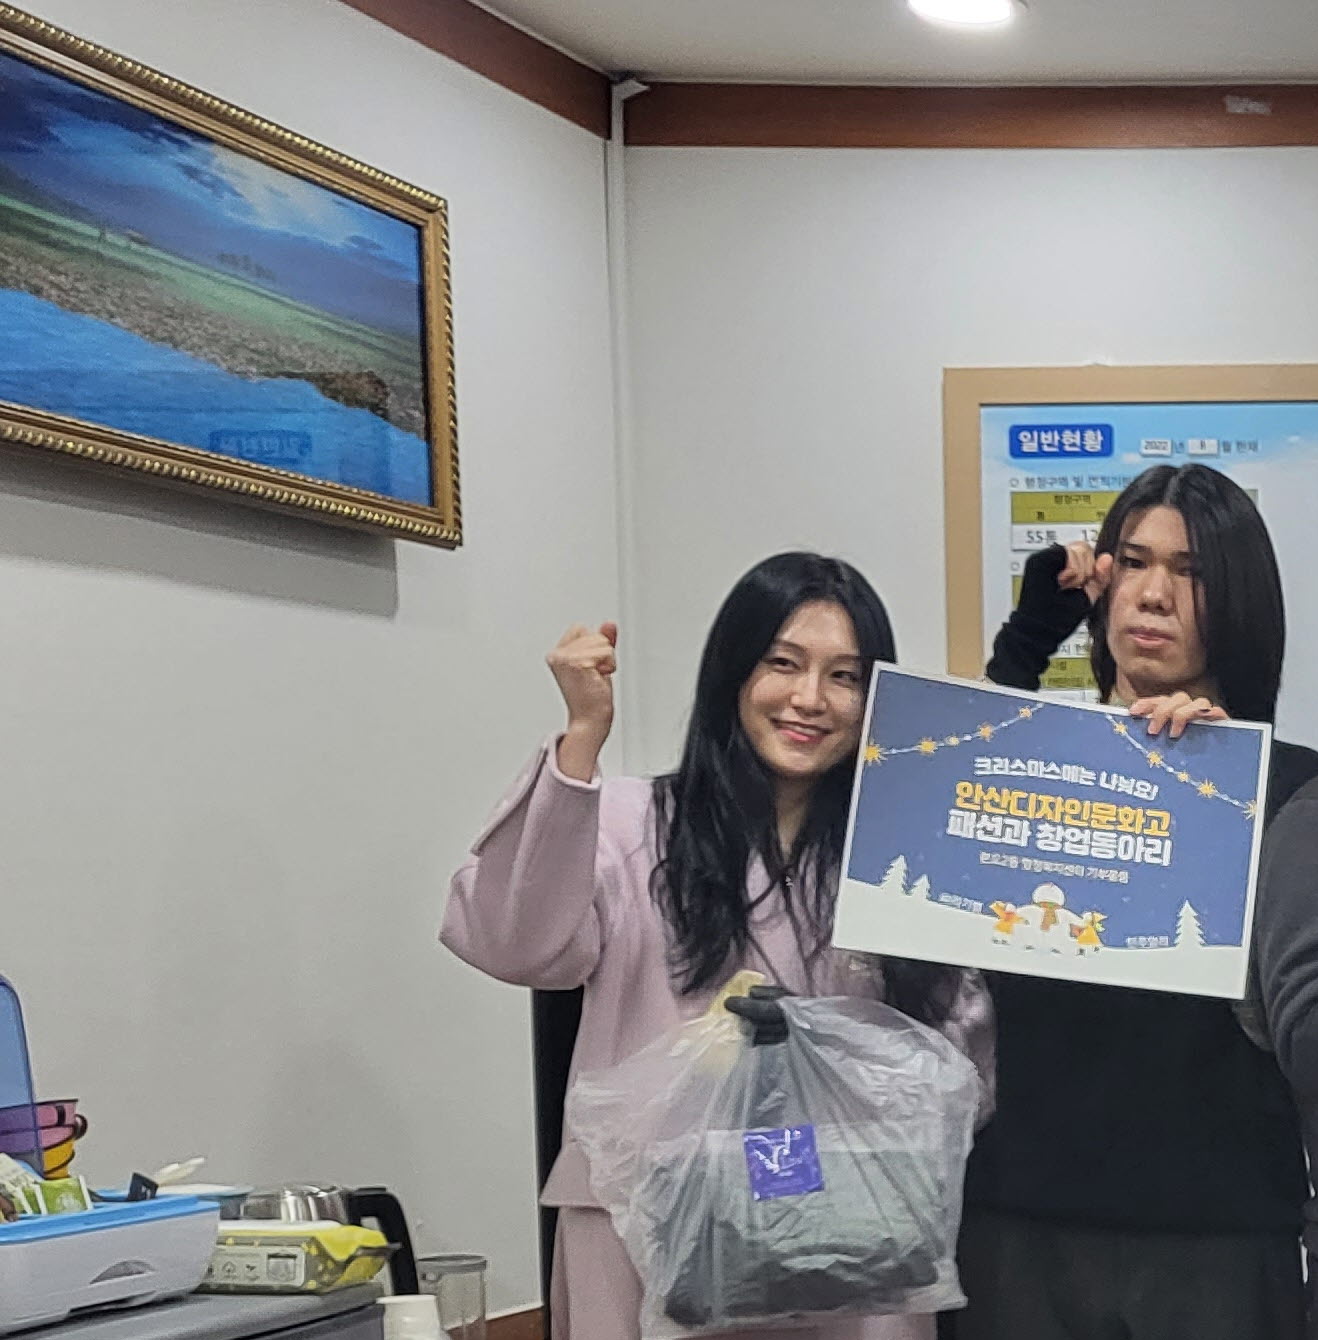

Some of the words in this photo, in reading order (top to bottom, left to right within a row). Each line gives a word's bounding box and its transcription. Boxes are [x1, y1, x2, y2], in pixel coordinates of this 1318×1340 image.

[1018, 430, 1104, 453] 일반현황
[974, 756, 1097, 787] 크리스마스에는
[1099, 769, 1159, 801] 나눠요!
[955, 781, 1171, 837] 안산디자인문화고
[946, 809, 1032, 848] 패션과
[1035, 823, 1172, 867] 창업동아리
